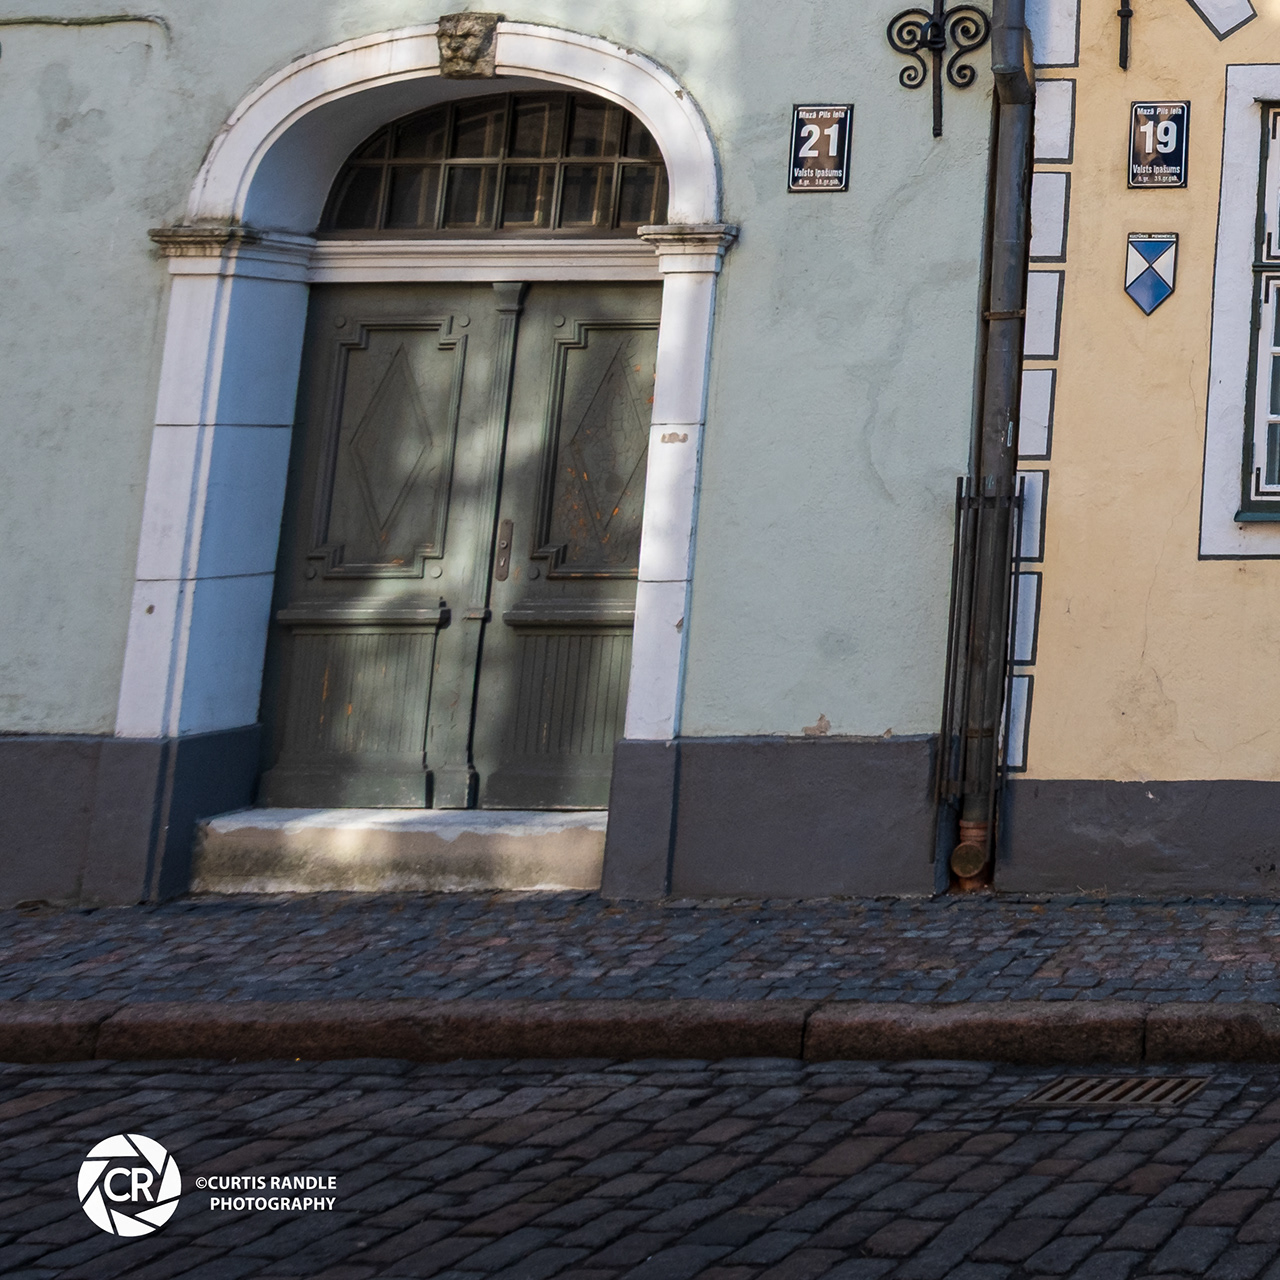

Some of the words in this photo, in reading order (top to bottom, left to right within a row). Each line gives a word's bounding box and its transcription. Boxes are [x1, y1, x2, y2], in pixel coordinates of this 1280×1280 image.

[1156, 107, 1169, 115] Pils
[798, 124, 839, 158] 21
[1140, 120, 1177, 154] 19
[794, 167, 814, 177] Valsts
[1133, 164, 1152, 174] Valsts
